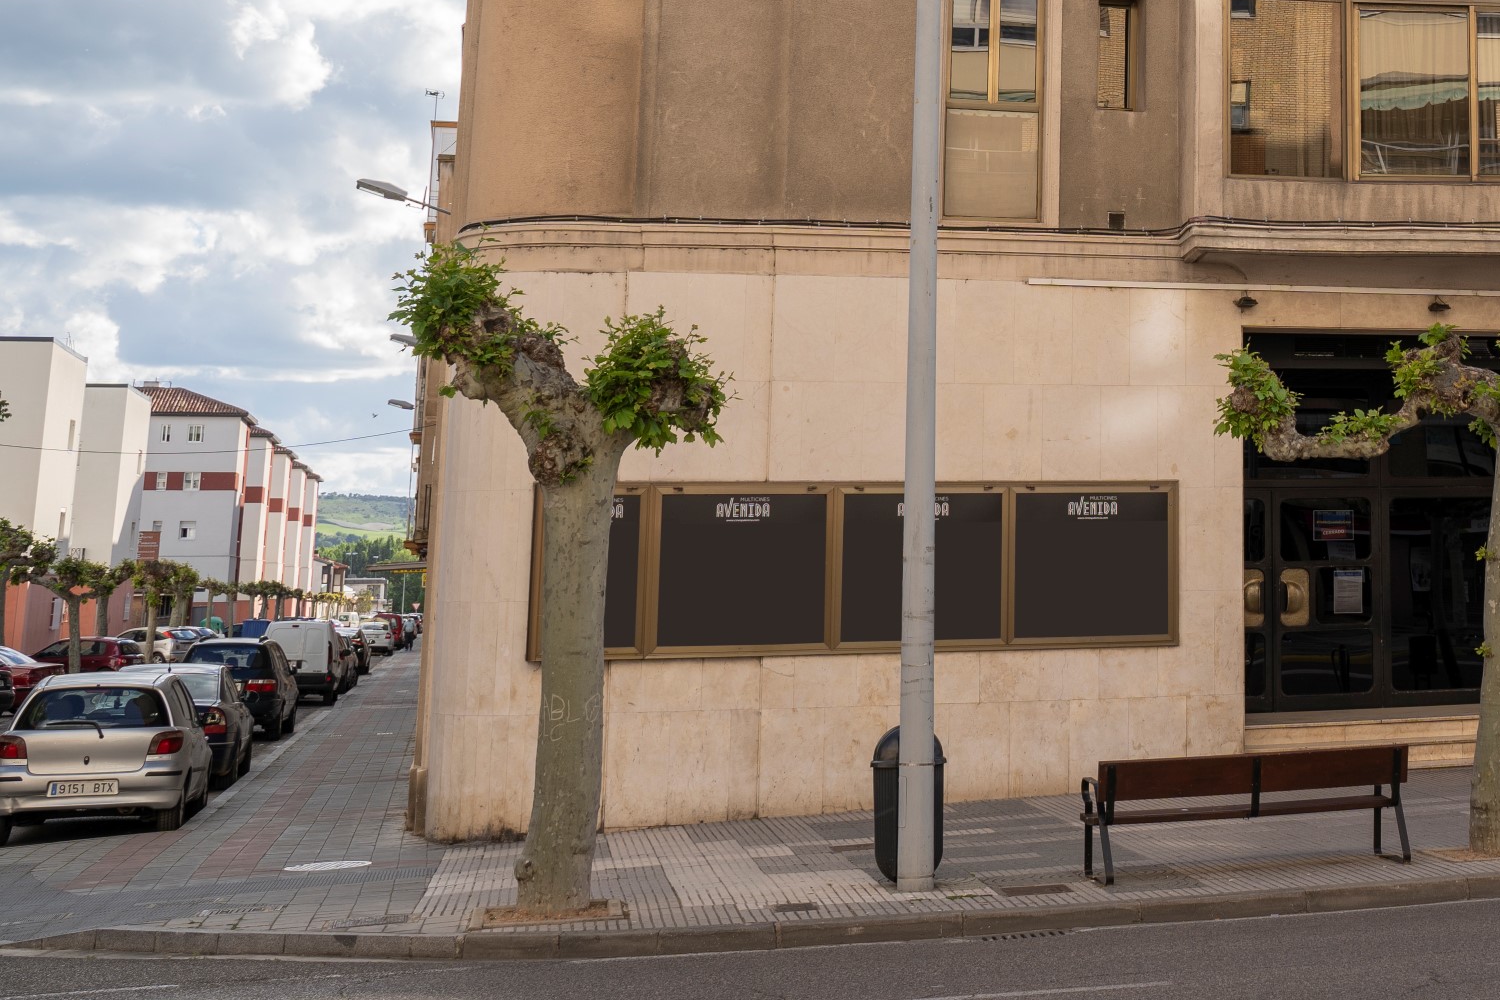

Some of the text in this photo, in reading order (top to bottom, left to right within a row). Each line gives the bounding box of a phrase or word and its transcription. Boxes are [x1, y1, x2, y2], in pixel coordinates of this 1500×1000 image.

[715, 496, 771, 518] AVENIDA
[1067, 495, 1118, 516] AVENIDA
[59, 782, 114, 794] 9151 BTX
